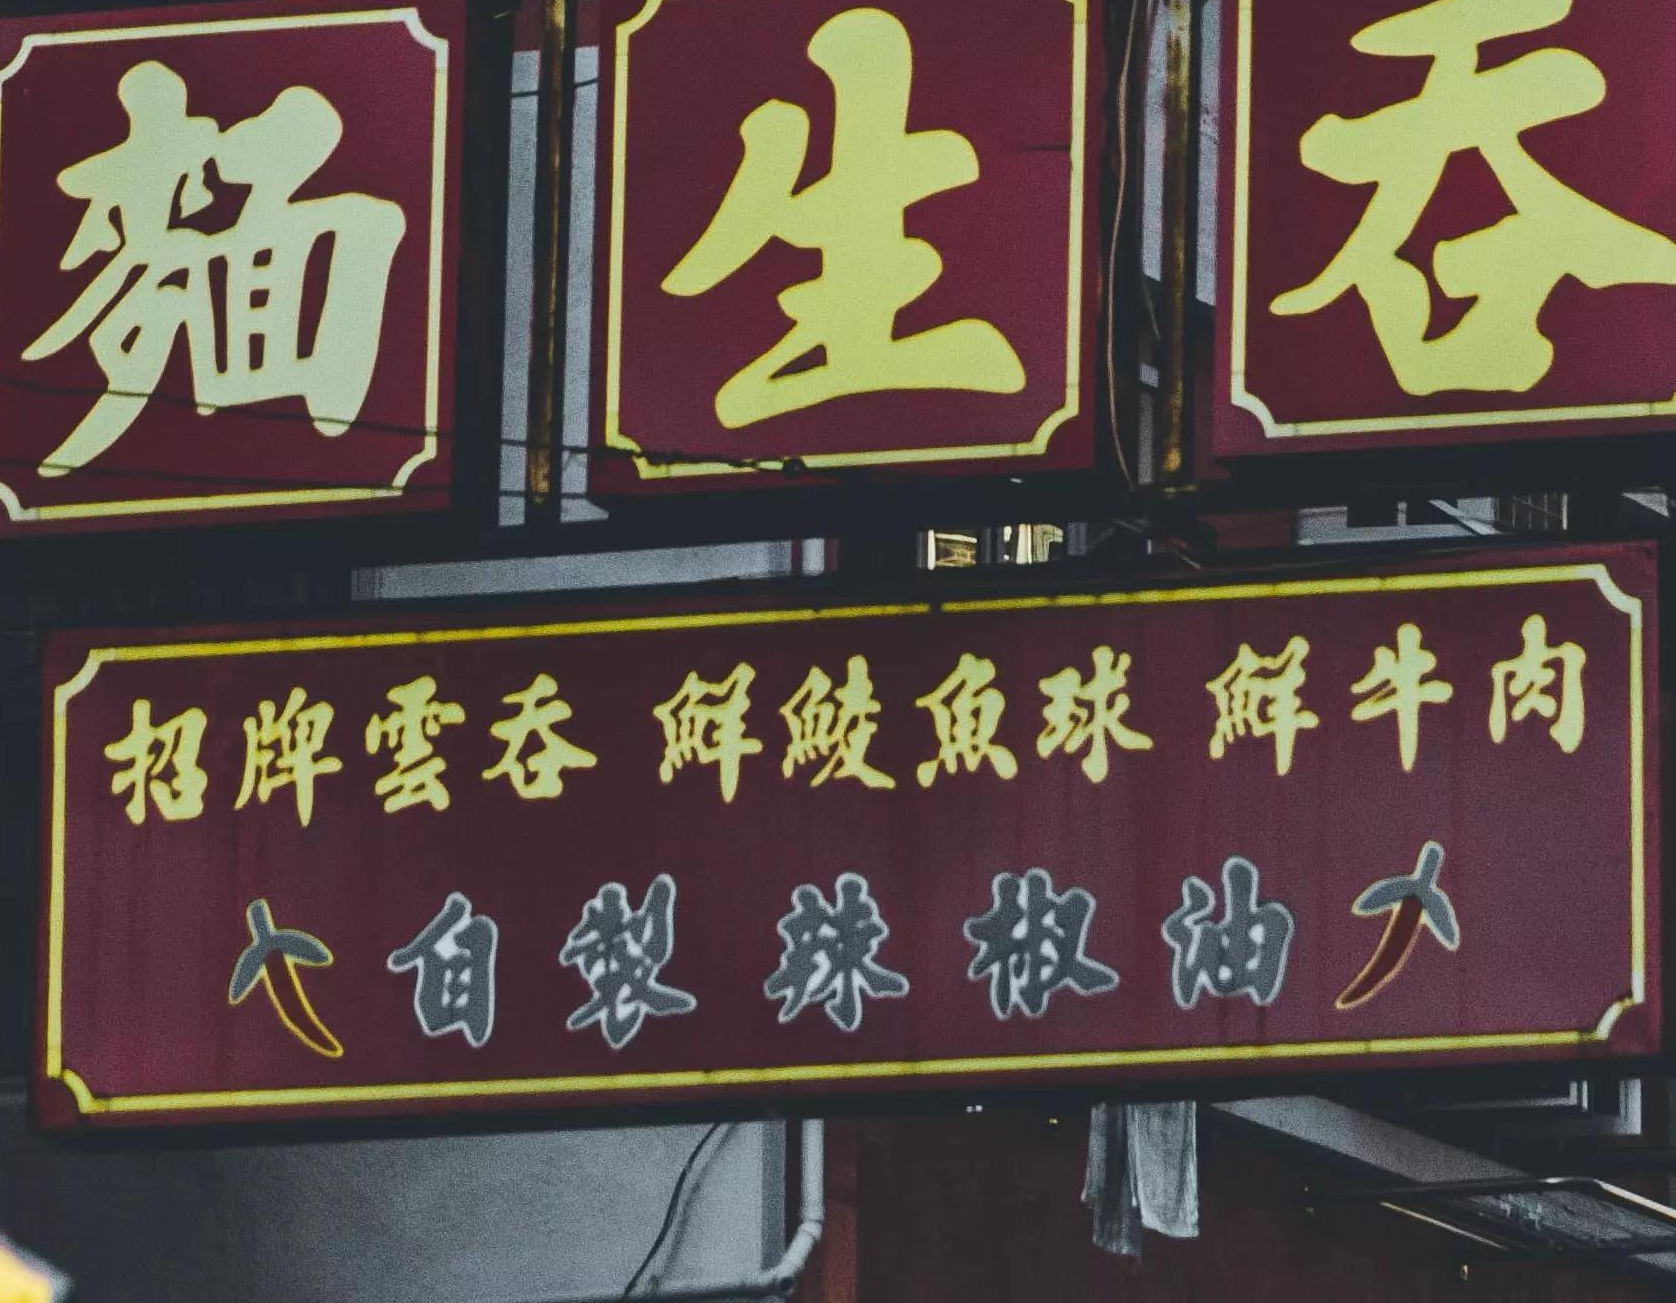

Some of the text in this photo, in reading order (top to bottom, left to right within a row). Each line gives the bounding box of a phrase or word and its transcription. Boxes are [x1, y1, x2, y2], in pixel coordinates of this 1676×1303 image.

[104, 673, 598, 827] 招牌雲吞
[1204, 614, 1587, 777] 鮮牛肉
